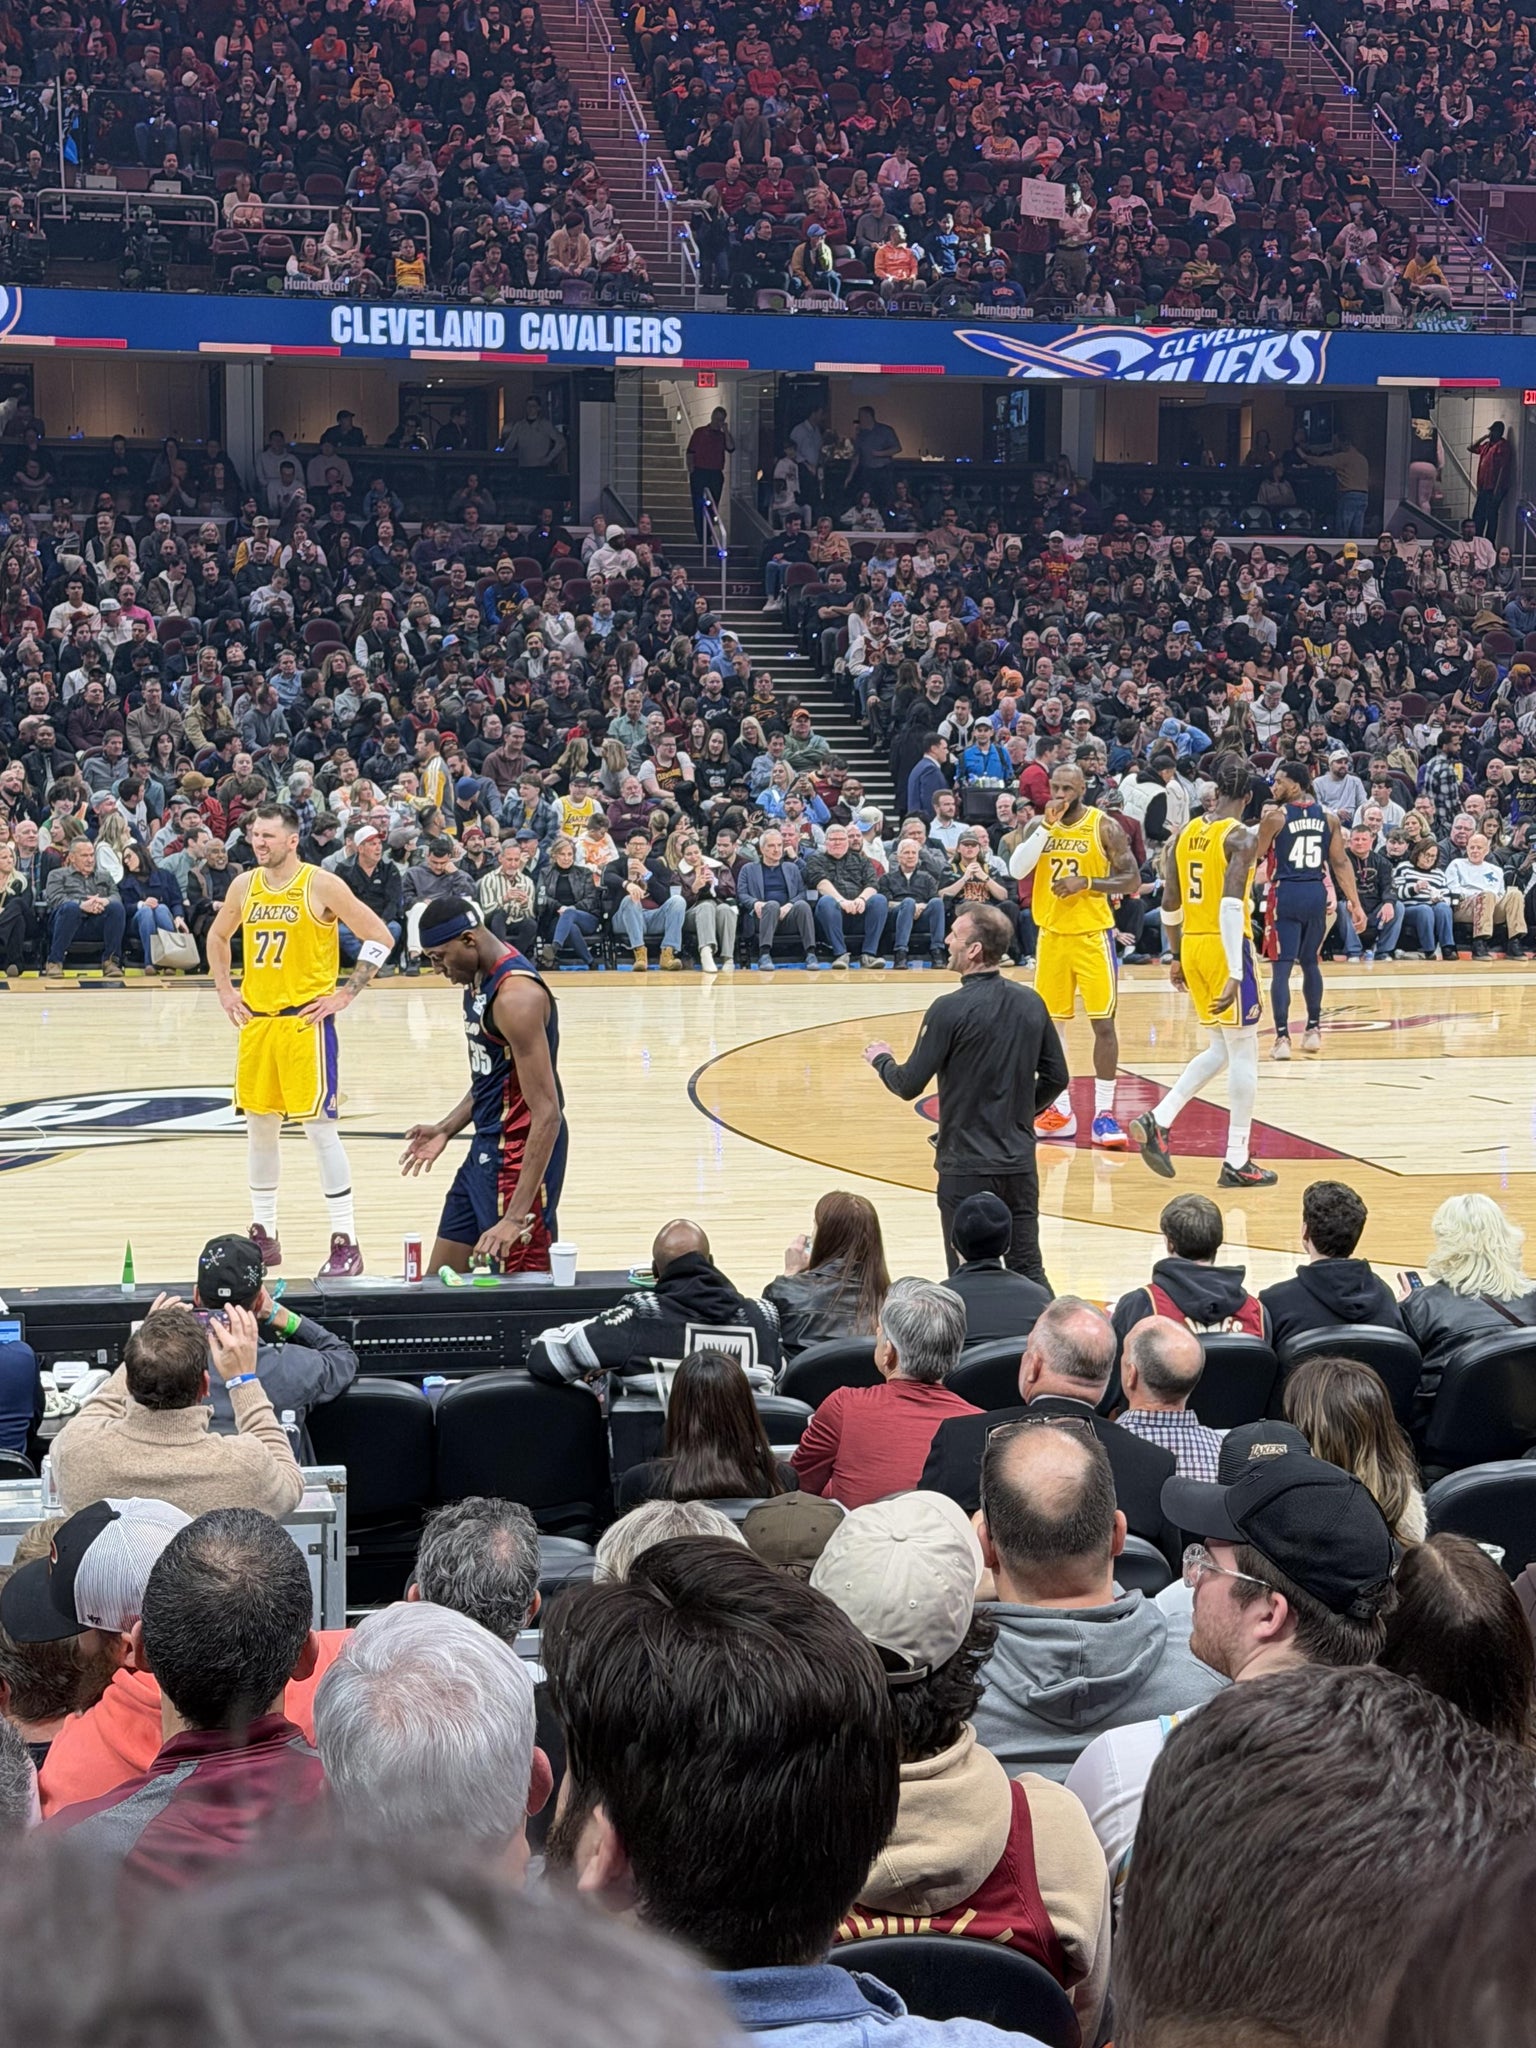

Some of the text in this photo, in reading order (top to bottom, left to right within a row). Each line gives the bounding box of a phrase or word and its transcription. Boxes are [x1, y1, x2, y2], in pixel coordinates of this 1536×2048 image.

[284, 276, 349, 295] Huntington
[500, 285, 563, 301] Huntington
[973, 303, 1034, 318] Huntington
[1160, 305, 1218, 320] Huntington
[1341, 312, 1399, 327] Huntington
[330, 305, 683, 355] CLEVELAND CAVALIERS
[1041, 836, 1090, 853] LAKERS
[1288, 836, 1322, 869] 45
[1051, 858, 1079, 882] 23
[1189, 862, 1203, 900] 5
[246, 902, 300, 924] LAKERS
[255, 930, 287, 965] 77
[1248, 1443, 1288, 1461] LAKERS
